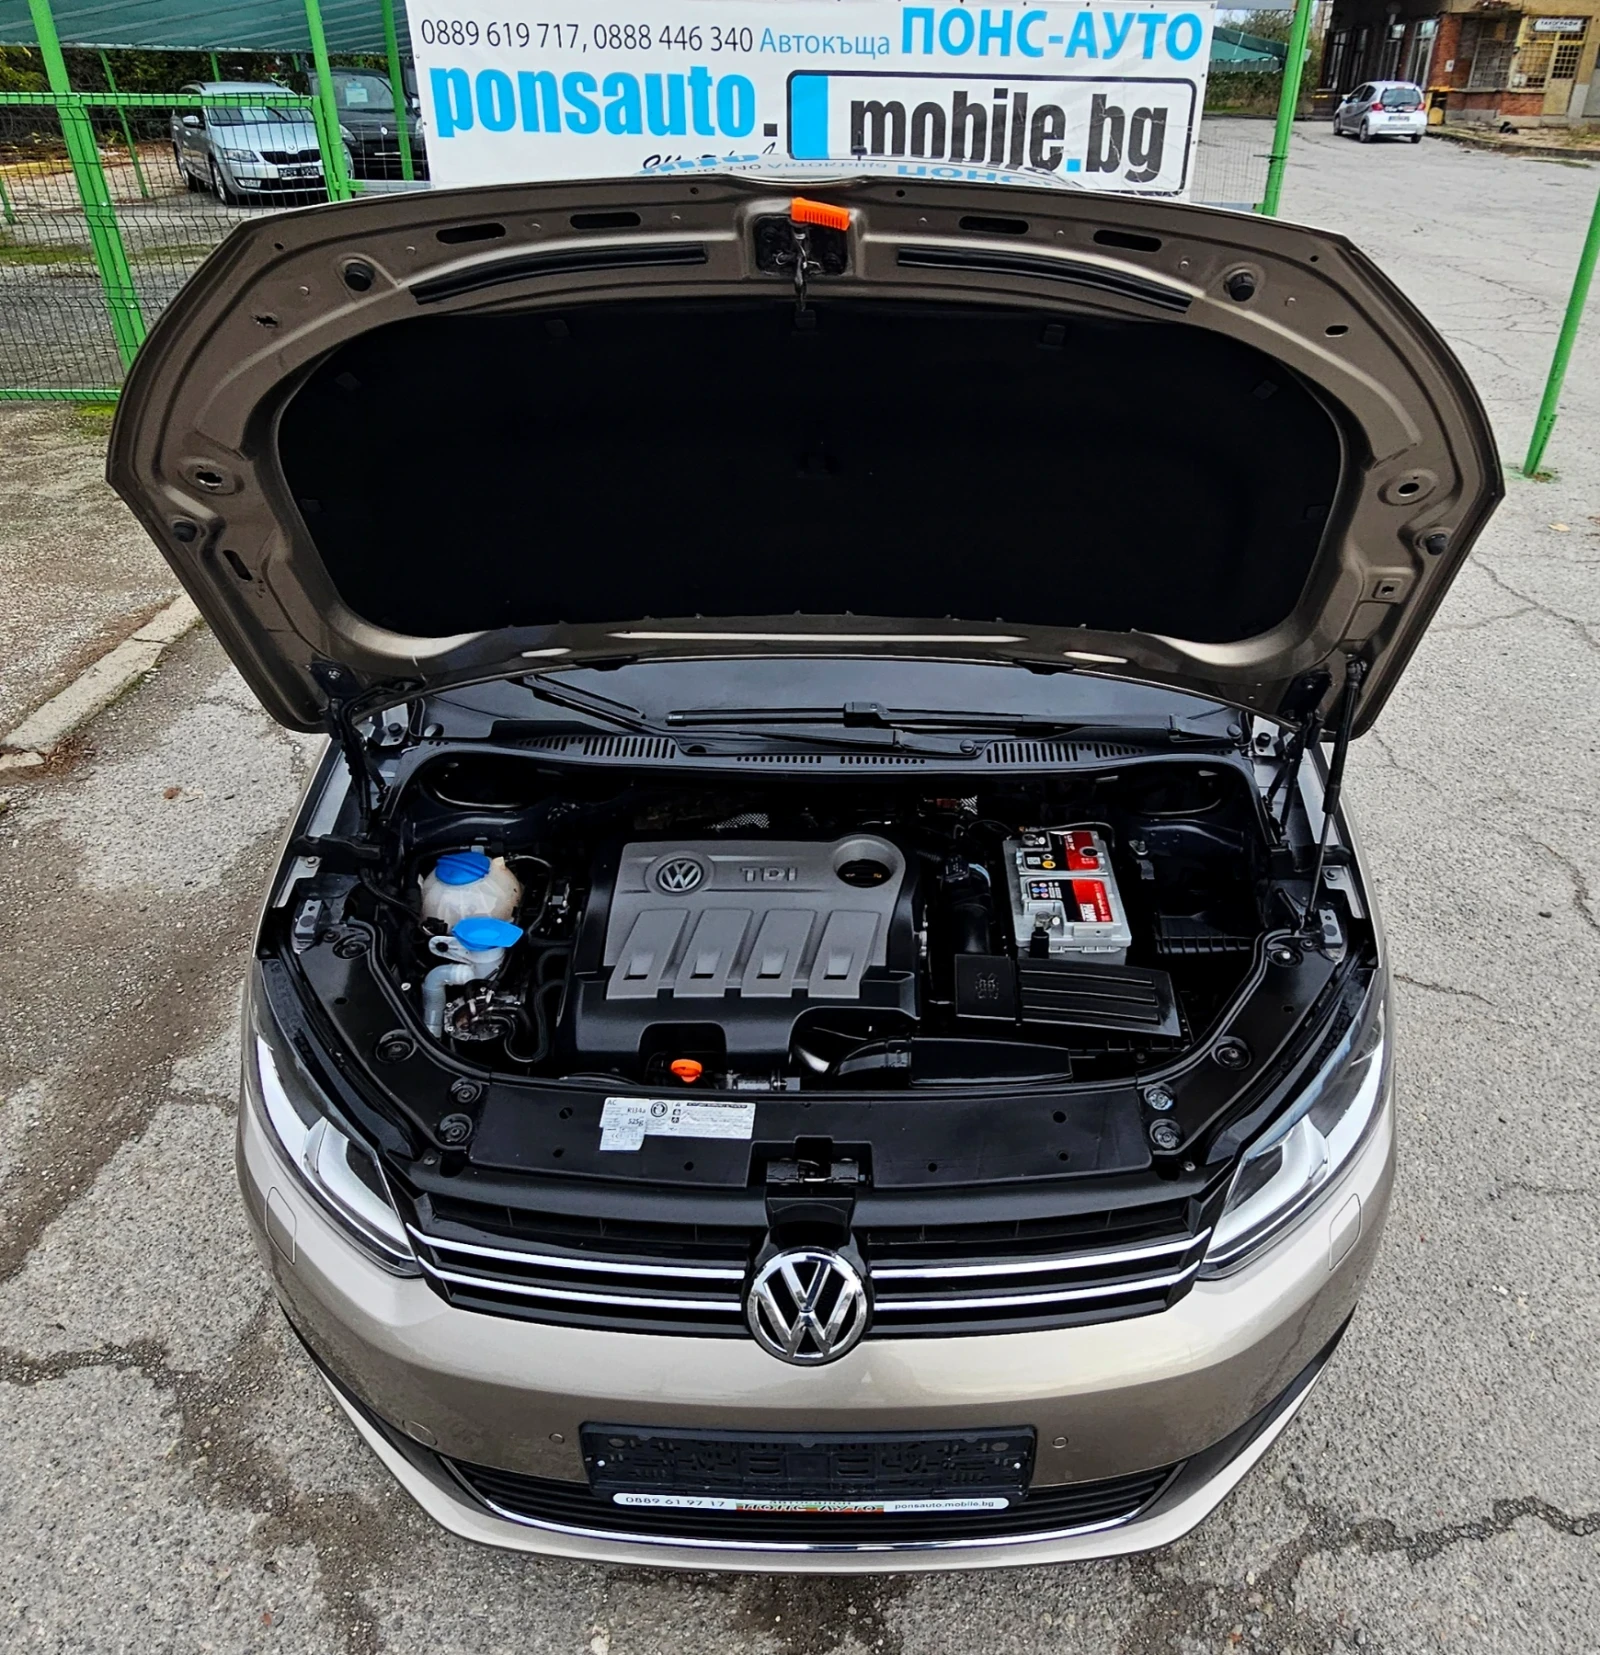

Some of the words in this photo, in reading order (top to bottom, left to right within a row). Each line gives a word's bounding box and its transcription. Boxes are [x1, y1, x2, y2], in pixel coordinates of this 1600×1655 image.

[421, 19, 480, 46] 0889
[486, 21, 530, 49] 619
[537, 23, 588, 53] 717,
[594, 23, 652, 50] 0888
[659, 25, 702, 52] 446
[710, 27, 754, 53] 340
[760, 27, 890, 60] Автокъща
[901, 7, 1203, 62] ПОНС-АУТО
[850, 87, 1169, 184] mobile.bg
[740, 867, 798, 882] TDI
[625, 1496, 660, 1504] 0889
[894, 1499, 995, 1510] ponsauto.mobile.bg
